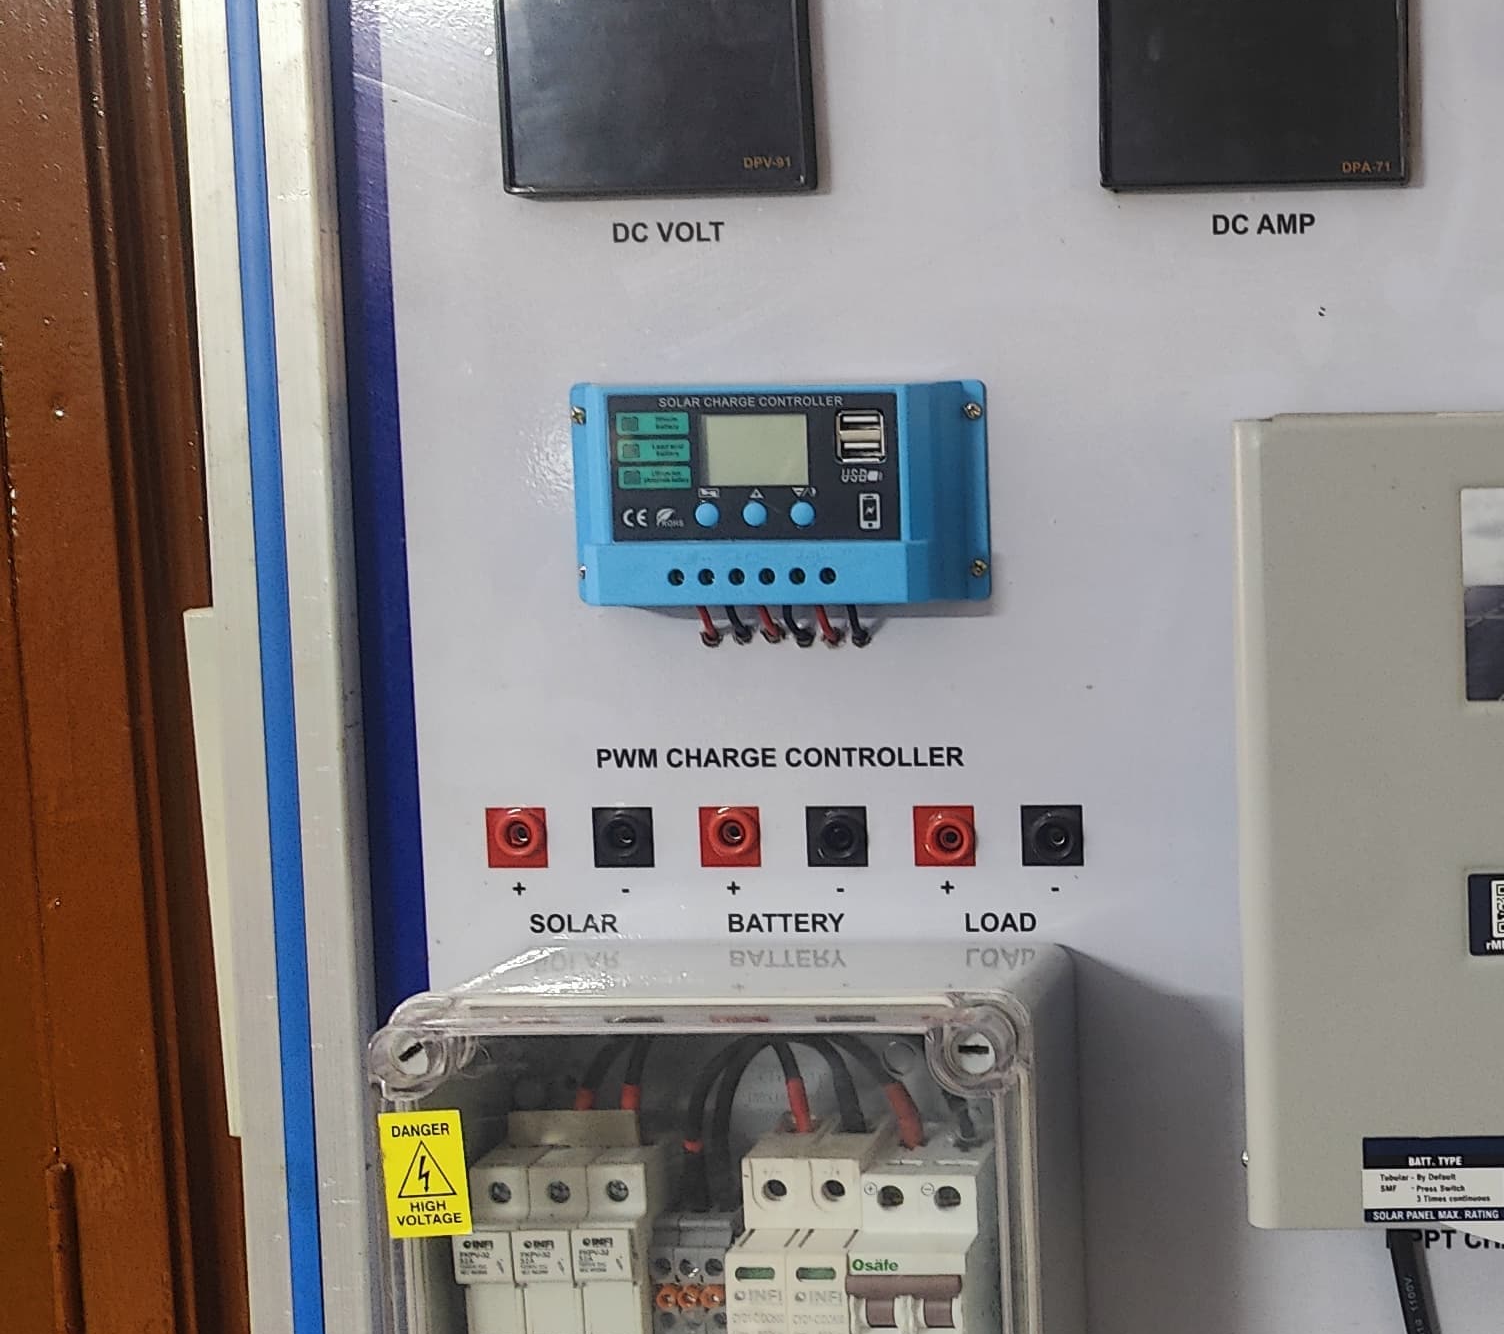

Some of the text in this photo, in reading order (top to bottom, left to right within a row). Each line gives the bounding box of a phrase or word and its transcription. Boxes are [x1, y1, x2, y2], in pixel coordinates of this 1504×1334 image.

[743, 156, 792, 170] DPV-91
[1341, 160, 1392, 175] DPA-71
[1211, 213, 1317, 236] DC AMP
[612, 221, 726, 244] DC VOLT
[658, 396, 844, 408] SOLAR CHARGE CONTROLLER
[596, 745, 966, 769] PWM CHARGE CONTROLLER
[528, 912, 620, 935] SOLAR
[727, 911, 846, 934] BATTERY
[964, 911, 1037, 933] LOAD
[391, 1122, 450, 1138] DANGER
[1408, 1156, 1463, 1166] BATT. TYPE
[410, 1199, 447, 1213] HIGH
[396, 1212, 464, 1227] VOLTAGE
[1372, 1209, 1500, 1221] SOLAR PANEL MAX. RATING
[852, 1258, 899, 1271] Osäfe
